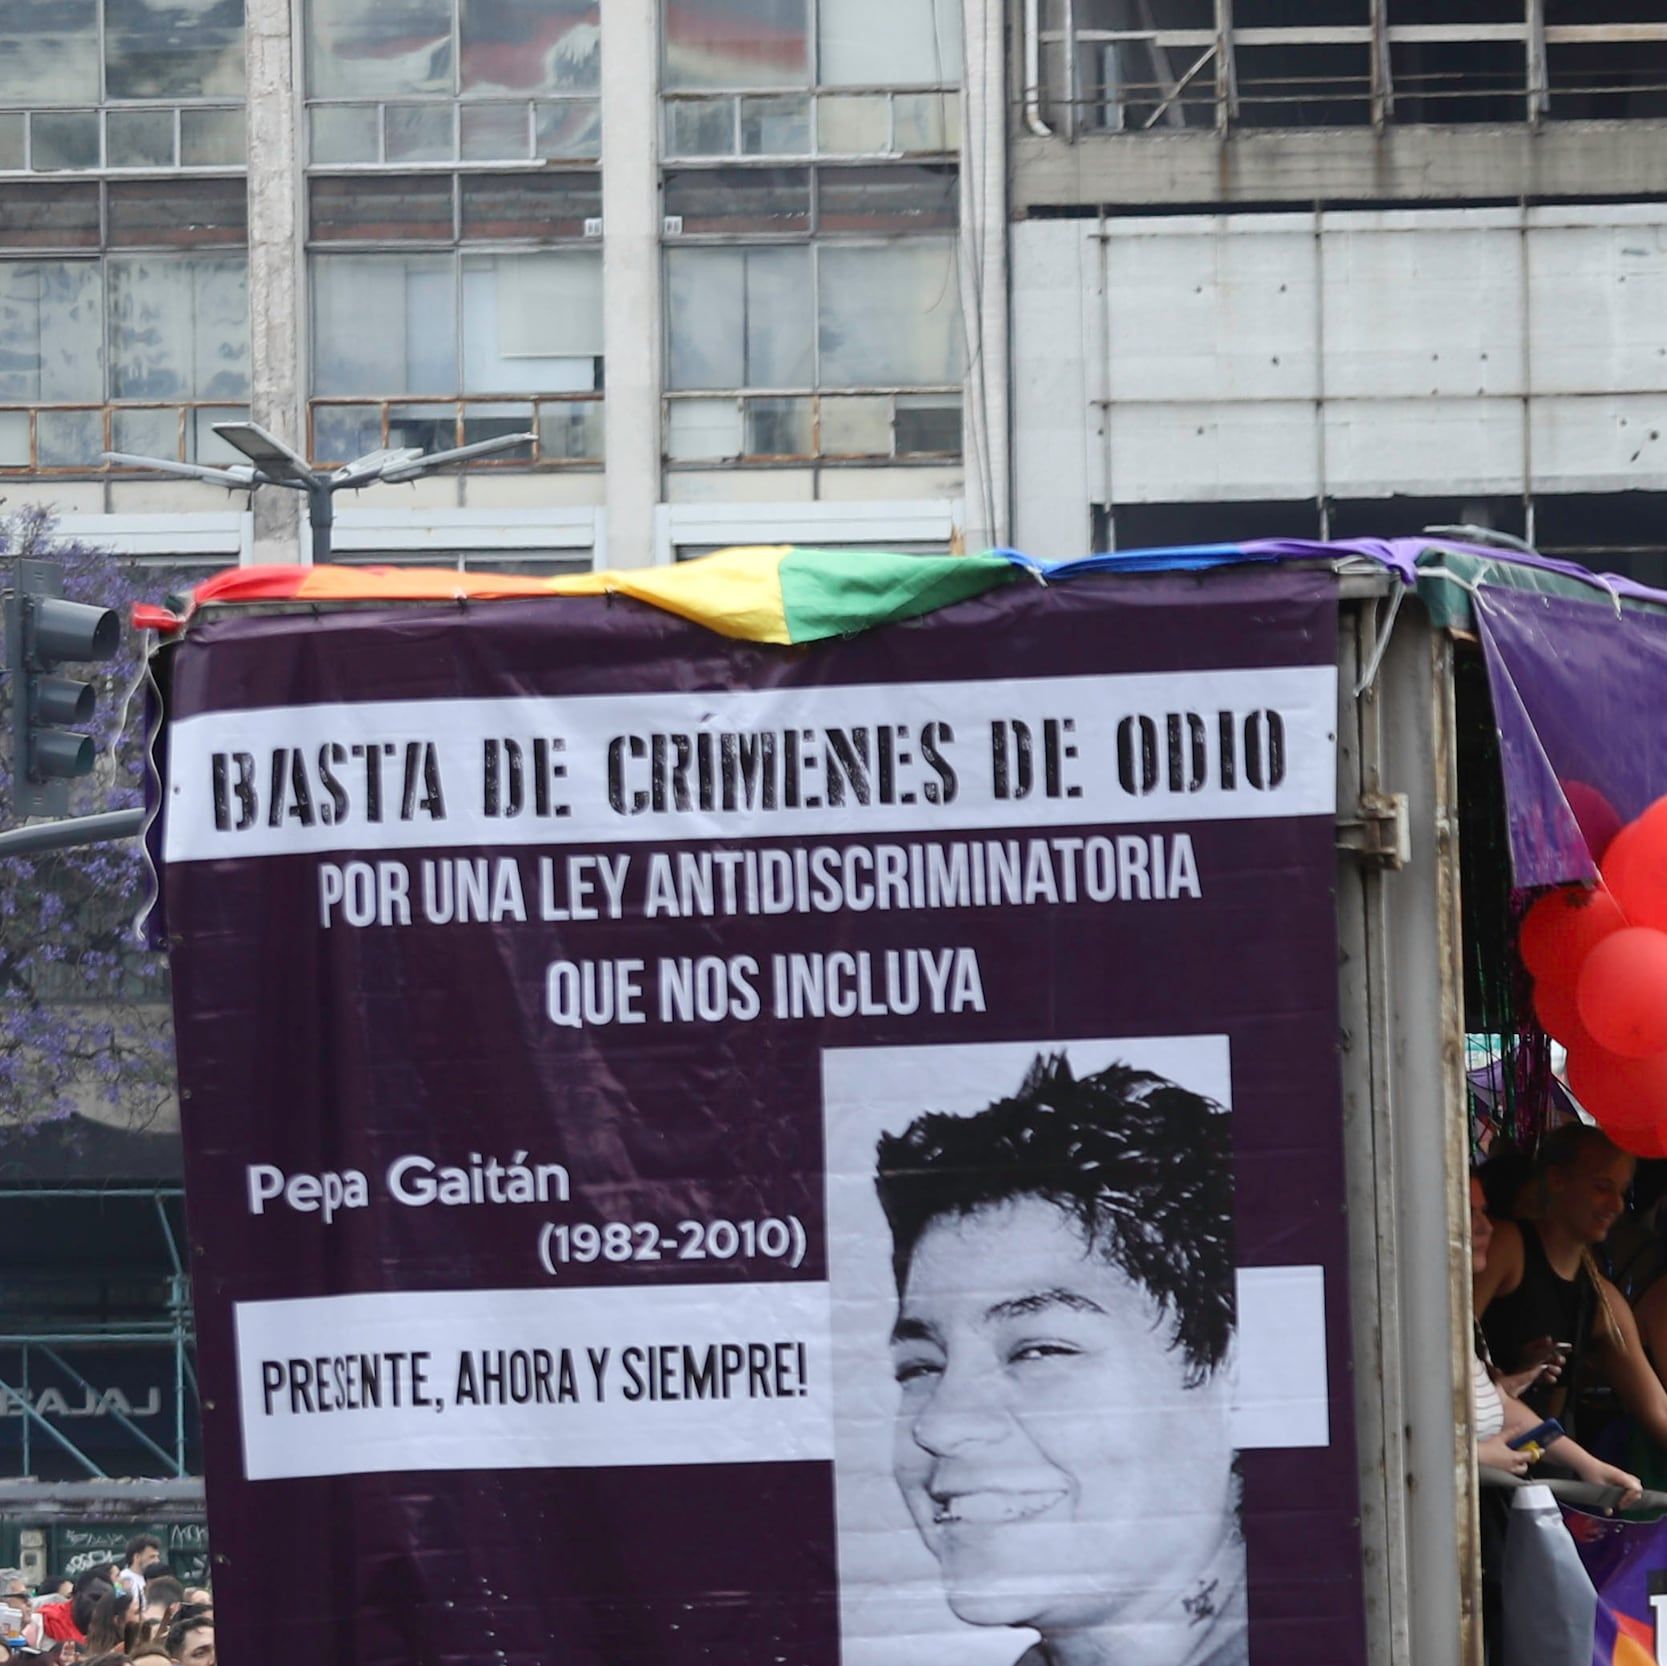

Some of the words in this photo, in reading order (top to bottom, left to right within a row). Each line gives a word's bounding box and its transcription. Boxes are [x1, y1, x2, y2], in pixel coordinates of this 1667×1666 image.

[211, 742, 447, 832] BASTA
[483, 737, 573, 819] DE
[607, 712, 959, 817] CRÍMENES
[991, 718, 1084, 801] DE
[1116, 708, 1287, 797] ODIO
[318, 860, 412, 929] POR
[420, 857, 528, 924] UNA
[537, 854, 631, 922] LEY
[644, 832, 1203, 918] ANTIDISCRIMINATORIA
[546, 959, 647, 1029] QUE
[658, 954, 761, 1024] NOS
[771, 947, 988, 1021] INCLUYA
[246, 1164, 370, 1225] Pepa
[386, 1150, 571, 1207] Gaitán
[538, 1215, 808, 1275] (1982-2010)
[262, 1350, 444, 1416] PRESENTE,
[456, 1347, 581, 1406] AHORA
[589, 1347, 611, 1402] Y
[622, 1341, 809, 1403] SIEMPRE!
